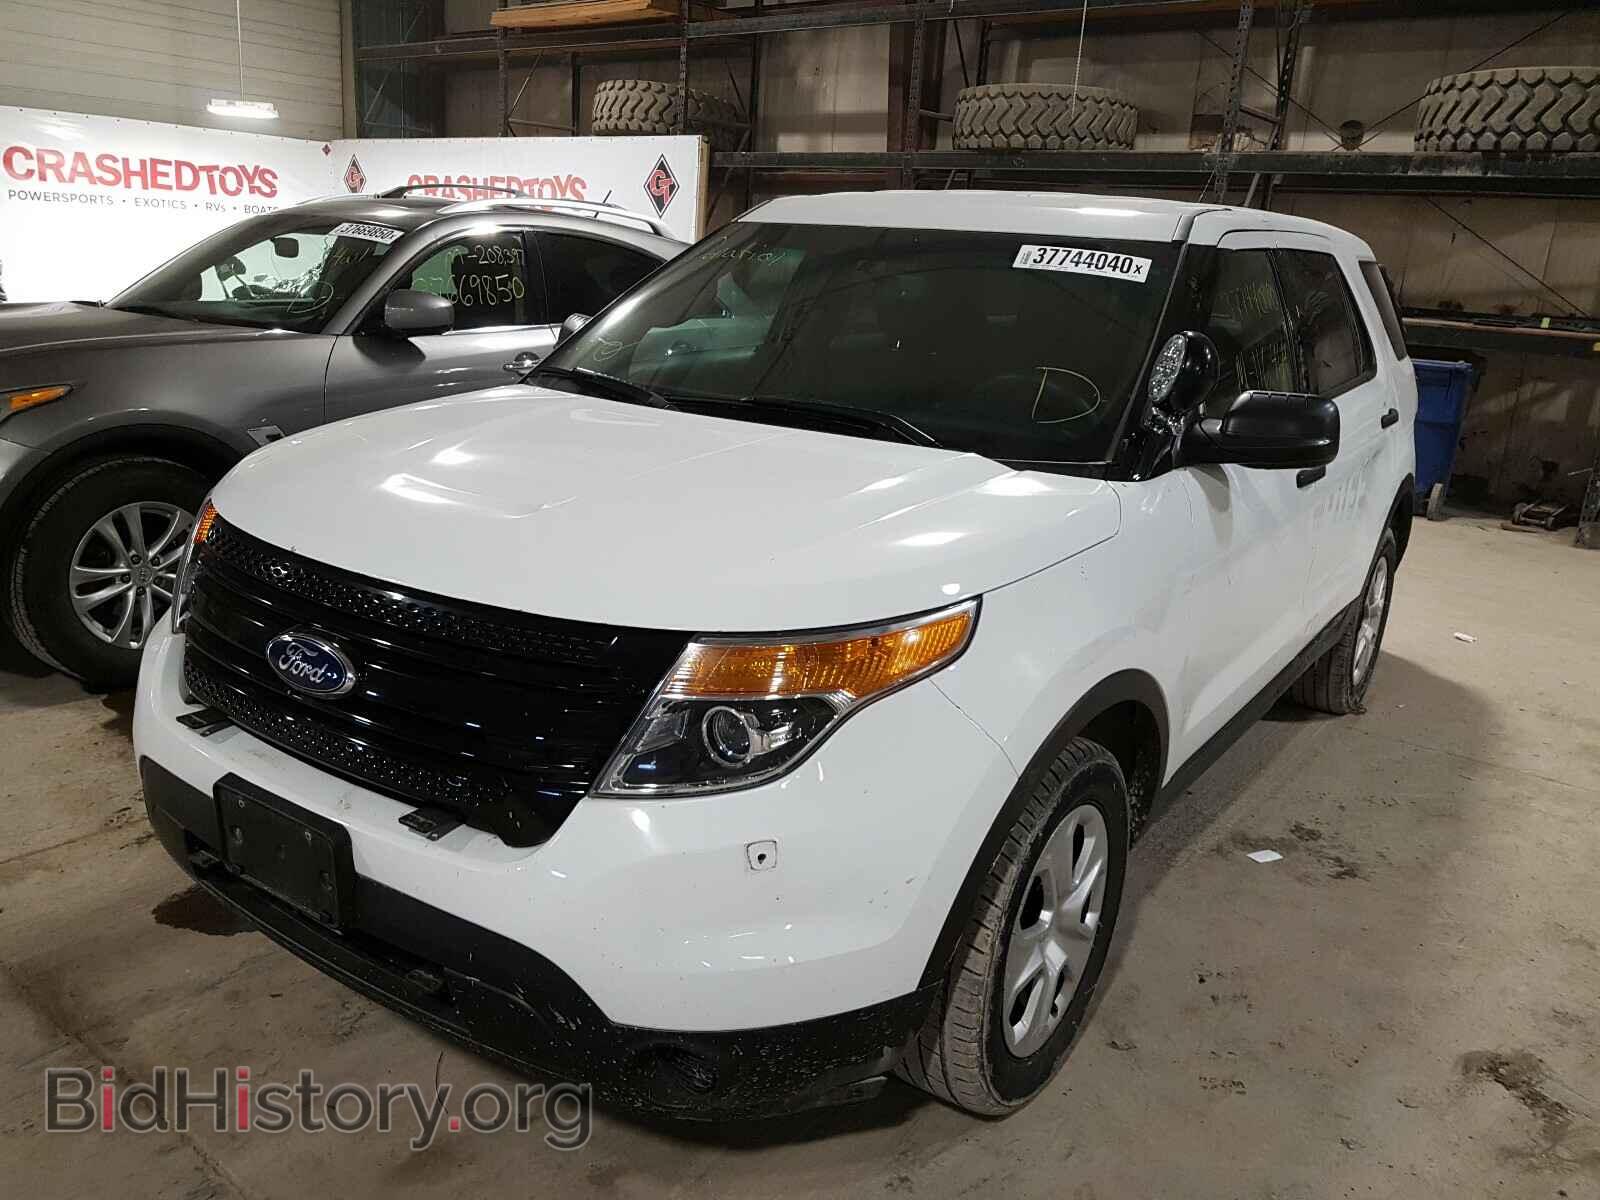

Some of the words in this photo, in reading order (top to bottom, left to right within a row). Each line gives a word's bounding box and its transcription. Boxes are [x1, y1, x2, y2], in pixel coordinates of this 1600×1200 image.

[3, 145, 279, 199] CRASHEDTOYS
[8, 189, 114, 204] POWERSPORTS
[134, 197, 188, 211] EXOTICS
[279, 642, 329, 683] Ford
